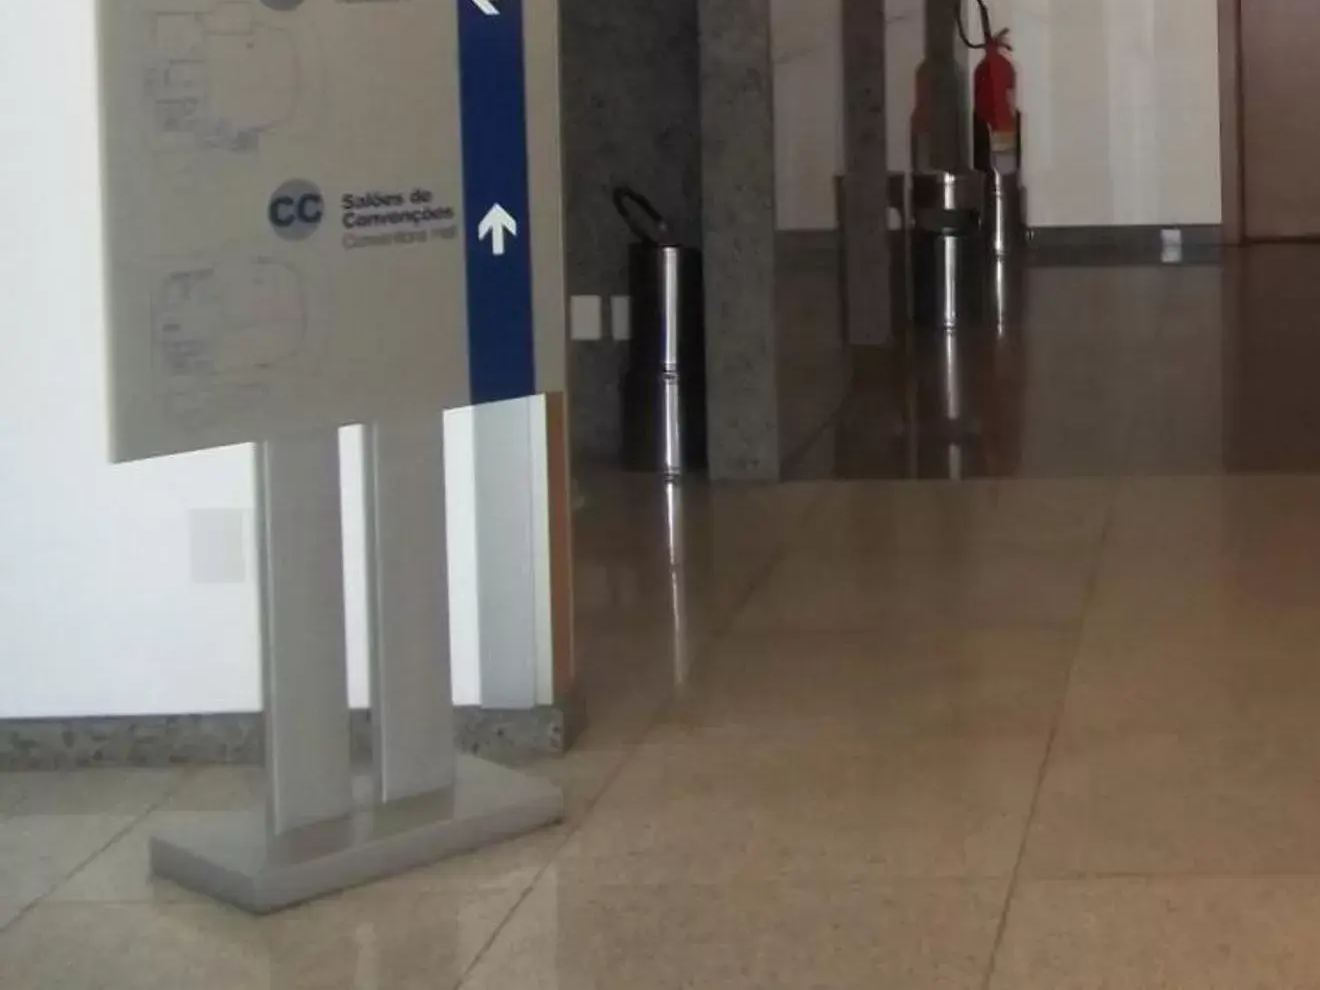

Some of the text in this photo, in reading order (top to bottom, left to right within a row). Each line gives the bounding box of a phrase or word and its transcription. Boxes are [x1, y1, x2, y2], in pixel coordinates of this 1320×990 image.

[268, 193, 323, 228] CC
[341, 189, 433, 210] Salões de
[342, 206, 455, 228] Convenções
